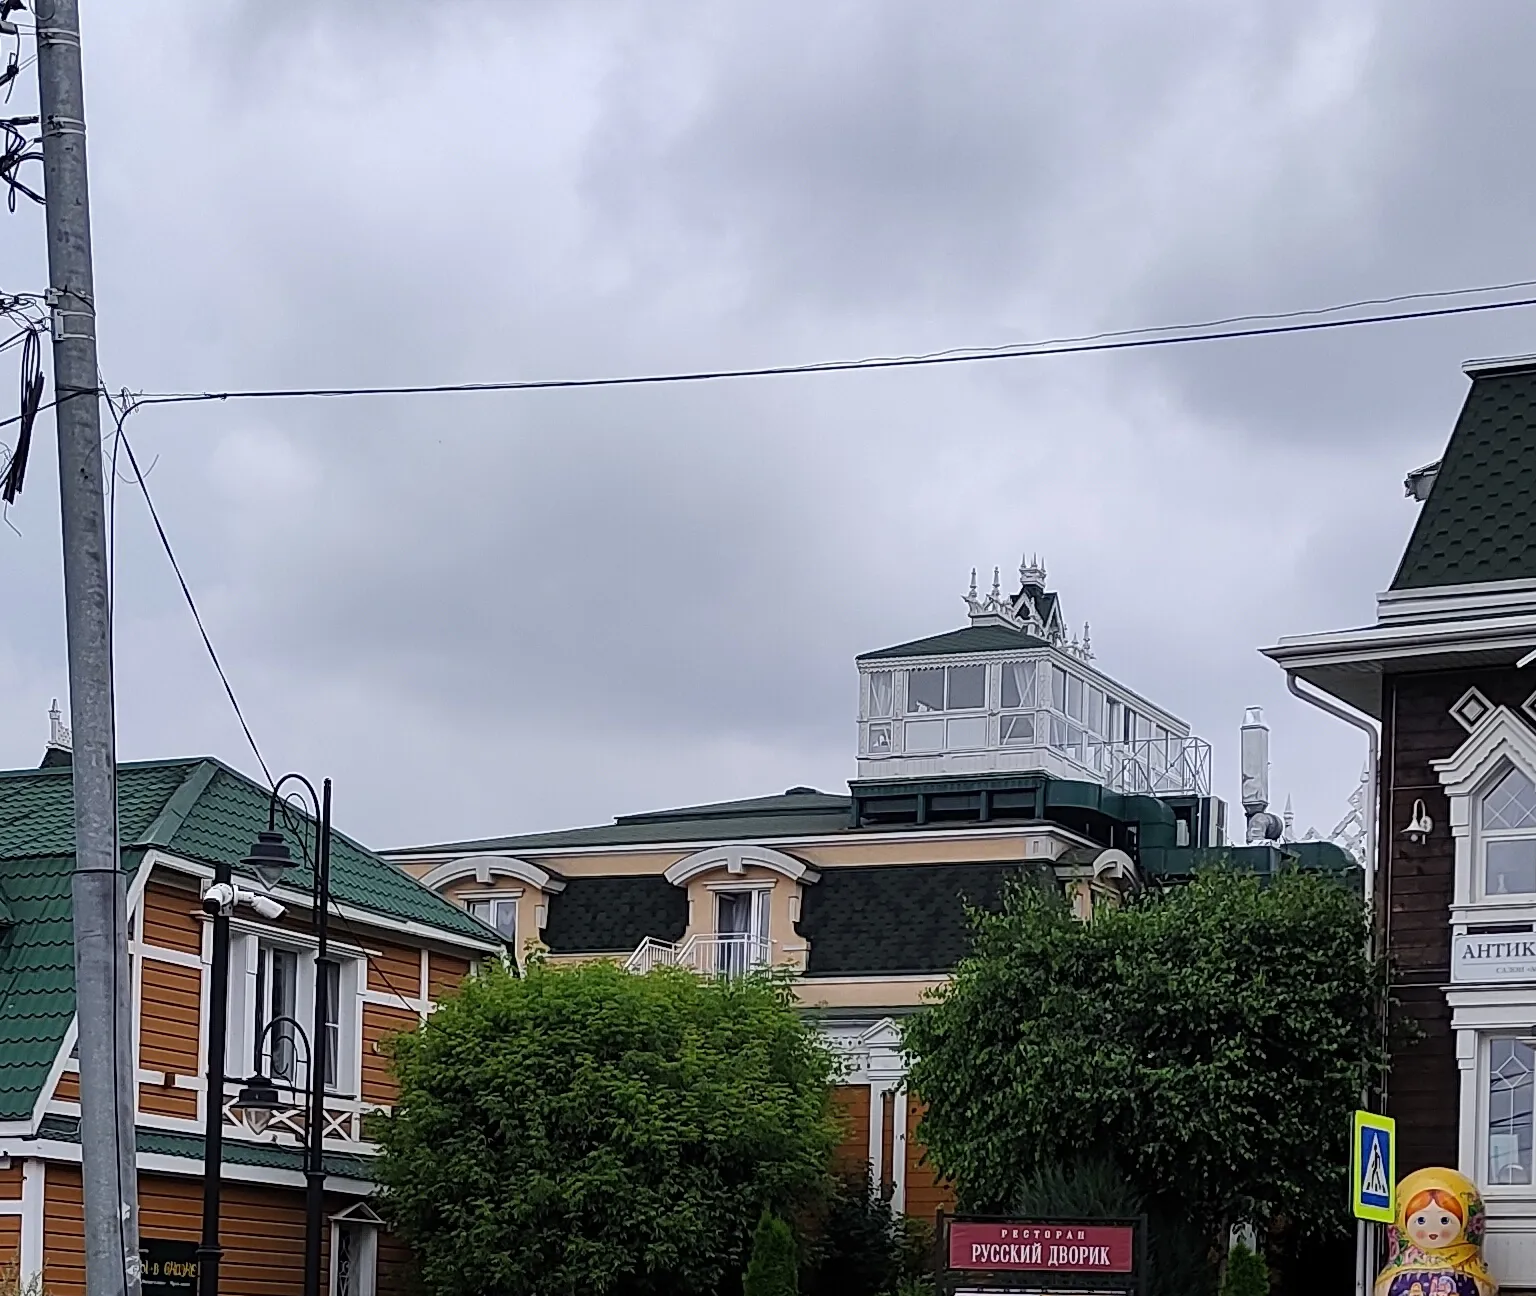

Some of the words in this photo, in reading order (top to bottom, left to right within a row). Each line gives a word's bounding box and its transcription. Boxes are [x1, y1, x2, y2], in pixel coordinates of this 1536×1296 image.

[1001, 1229, 1085, 1240] РЕСТОРАН
[971, 1243, 1042, 1264] РУССКИЙ
[1047, 1245, 1111, 1267] ДВОРИК
